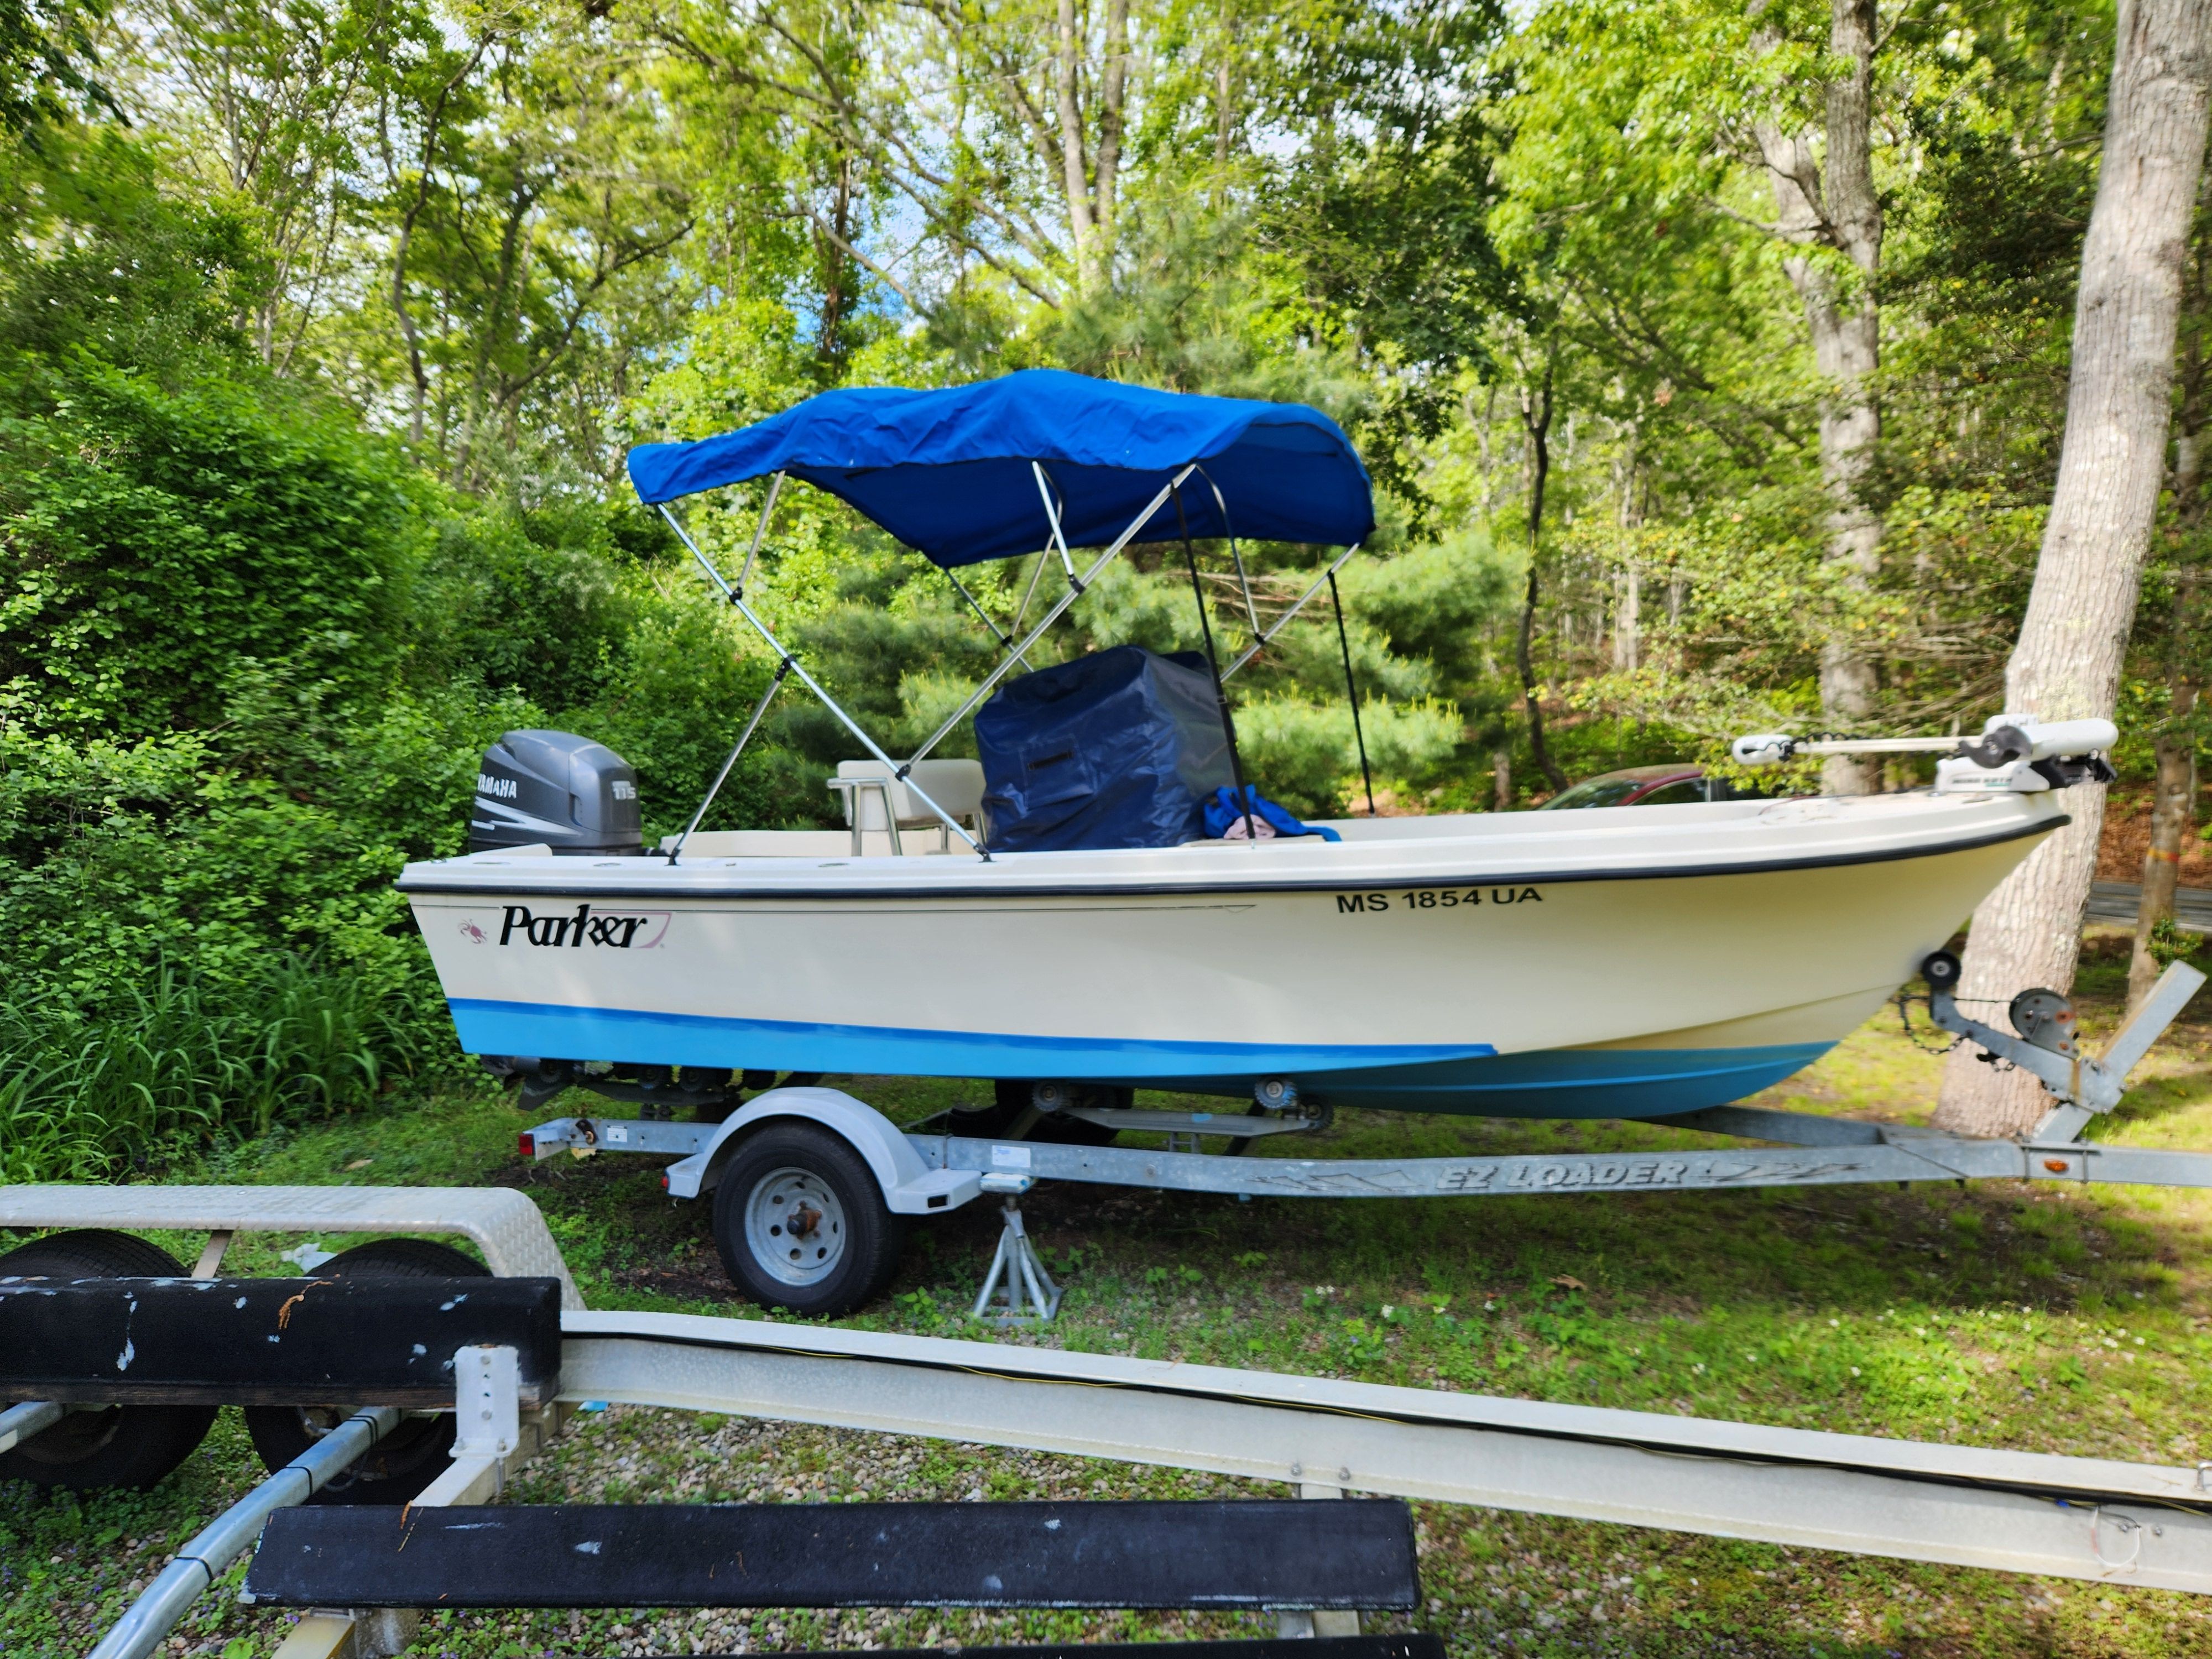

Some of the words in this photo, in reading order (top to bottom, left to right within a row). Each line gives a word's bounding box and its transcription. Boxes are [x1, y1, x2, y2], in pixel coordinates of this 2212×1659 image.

[478, 773, 517, 799] YAMAHA
[613, 786, 636, 800] 115
[1337, 893, 1389, 913] MS
[1402, 889, 1482, 909] 1854
[1491, 887, 1543, 905] UA
[500, 904, 648, 948] Parker
[1436, 1165, 1499, 1190] EZ
[1507, 1160, 1688, 1188] LOADER
